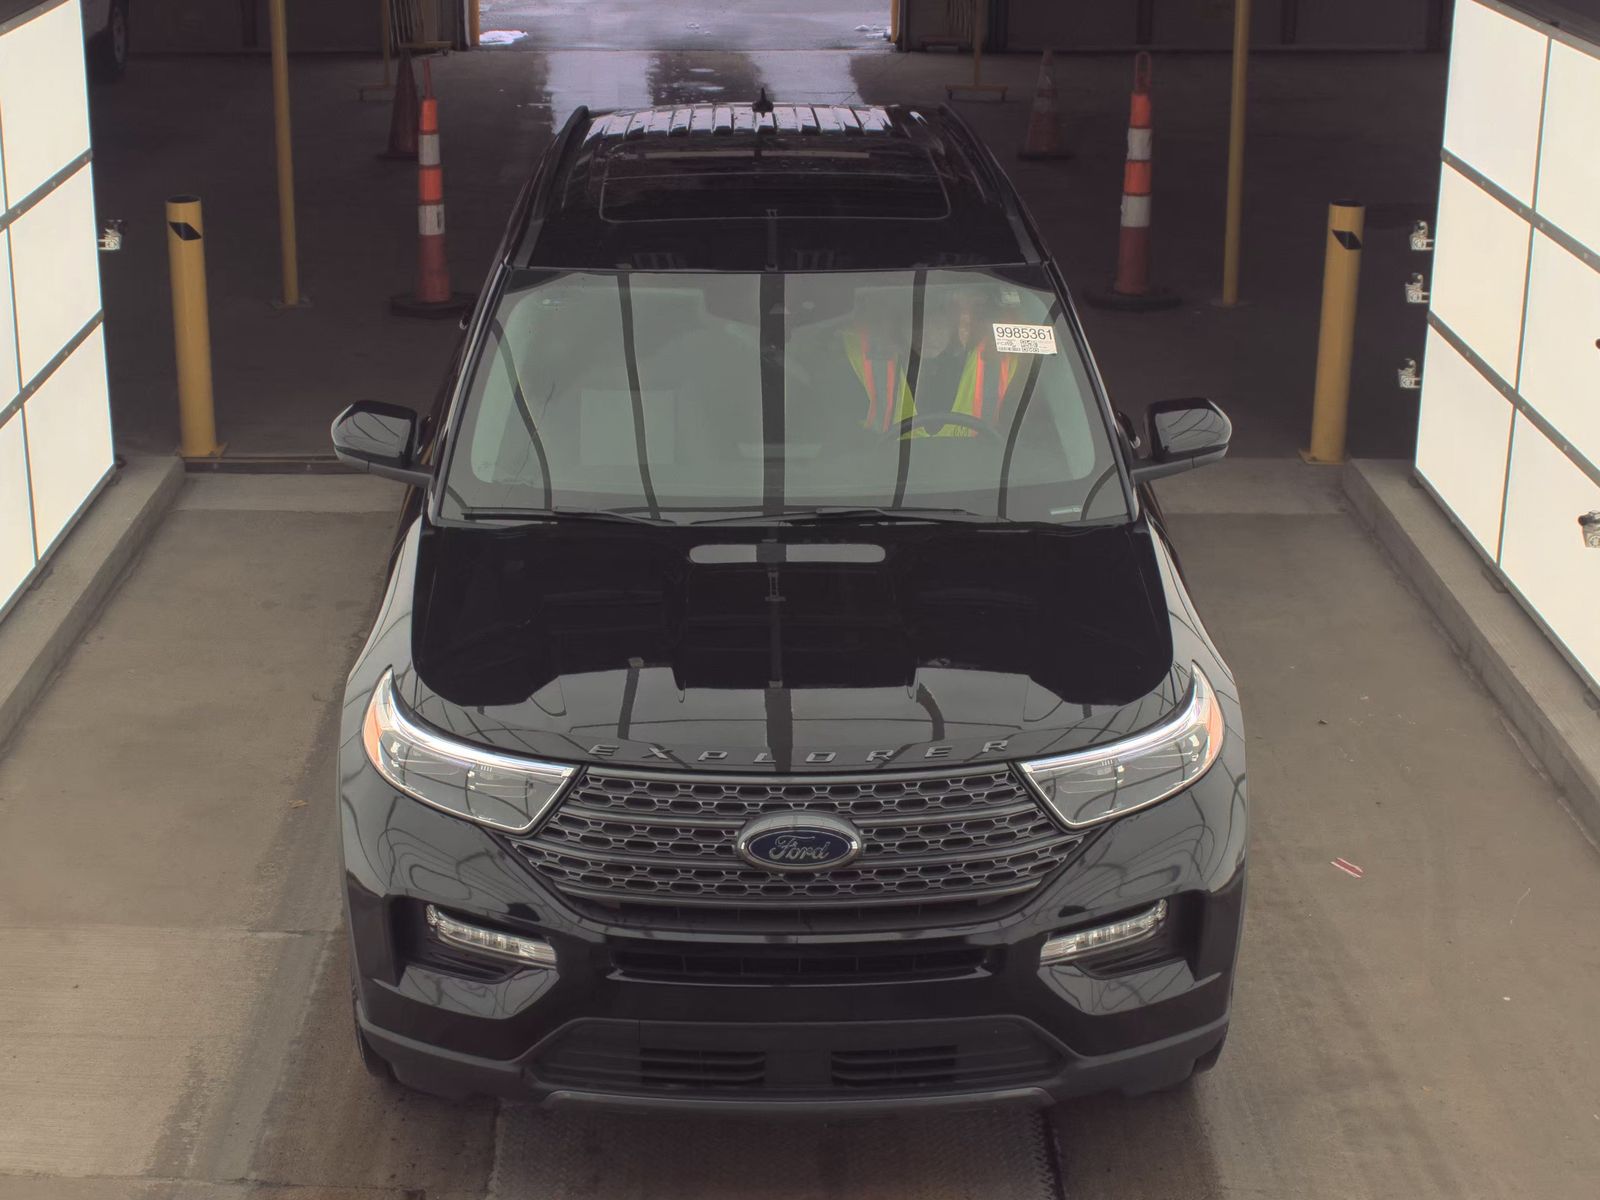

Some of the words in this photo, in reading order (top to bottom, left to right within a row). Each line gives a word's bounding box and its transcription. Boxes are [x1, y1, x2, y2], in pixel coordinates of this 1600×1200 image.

[996, 326, 1052, 340] 9985361
[588, 739, 1009, 764] EXPLORER
[769, 835, 831, 861] Ford
